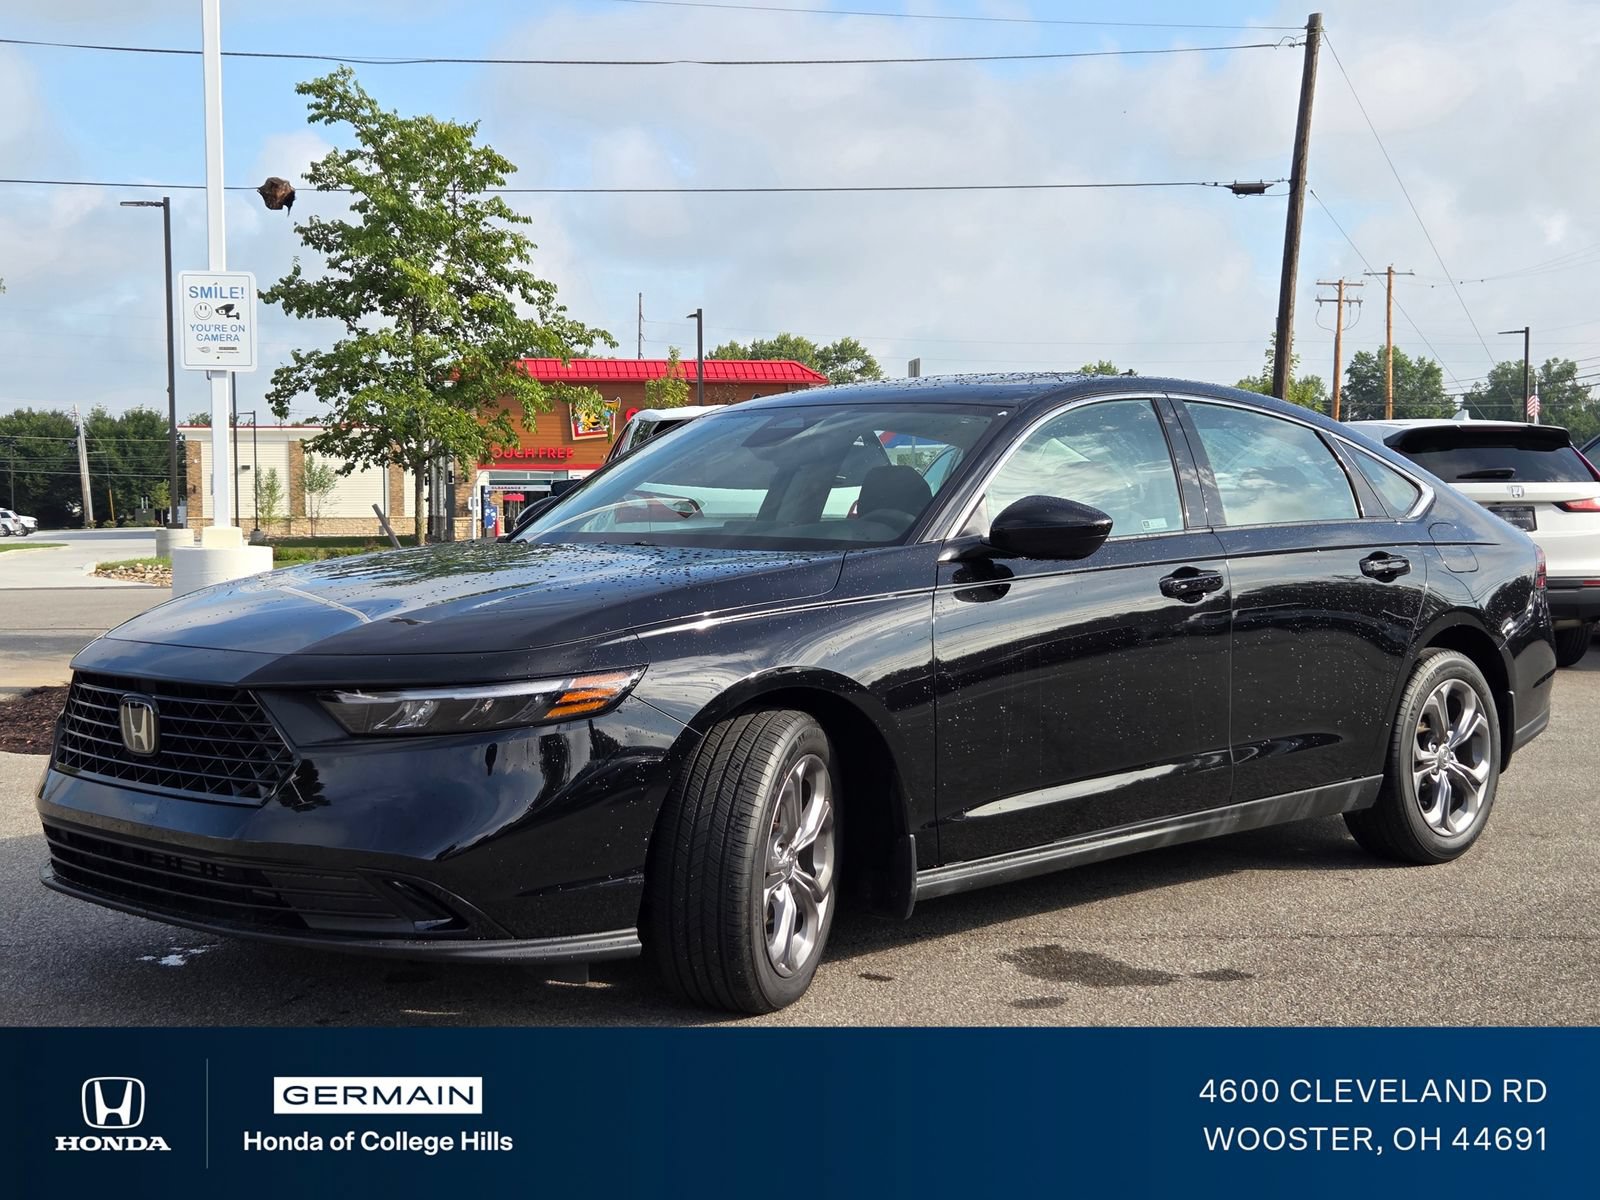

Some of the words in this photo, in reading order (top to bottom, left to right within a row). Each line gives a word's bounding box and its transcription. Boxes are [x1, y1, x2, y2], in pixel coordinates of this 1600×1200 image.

[188, 285, 244, 299] SMILE!
[190, 323, 228, 333] YOU'RE
[230, 324, 246, 333] ON
[196, 333, 240, 342] CAMERA
[490, 447, 535, 459] OUCH
[538, 447, 574, 459] FREE
